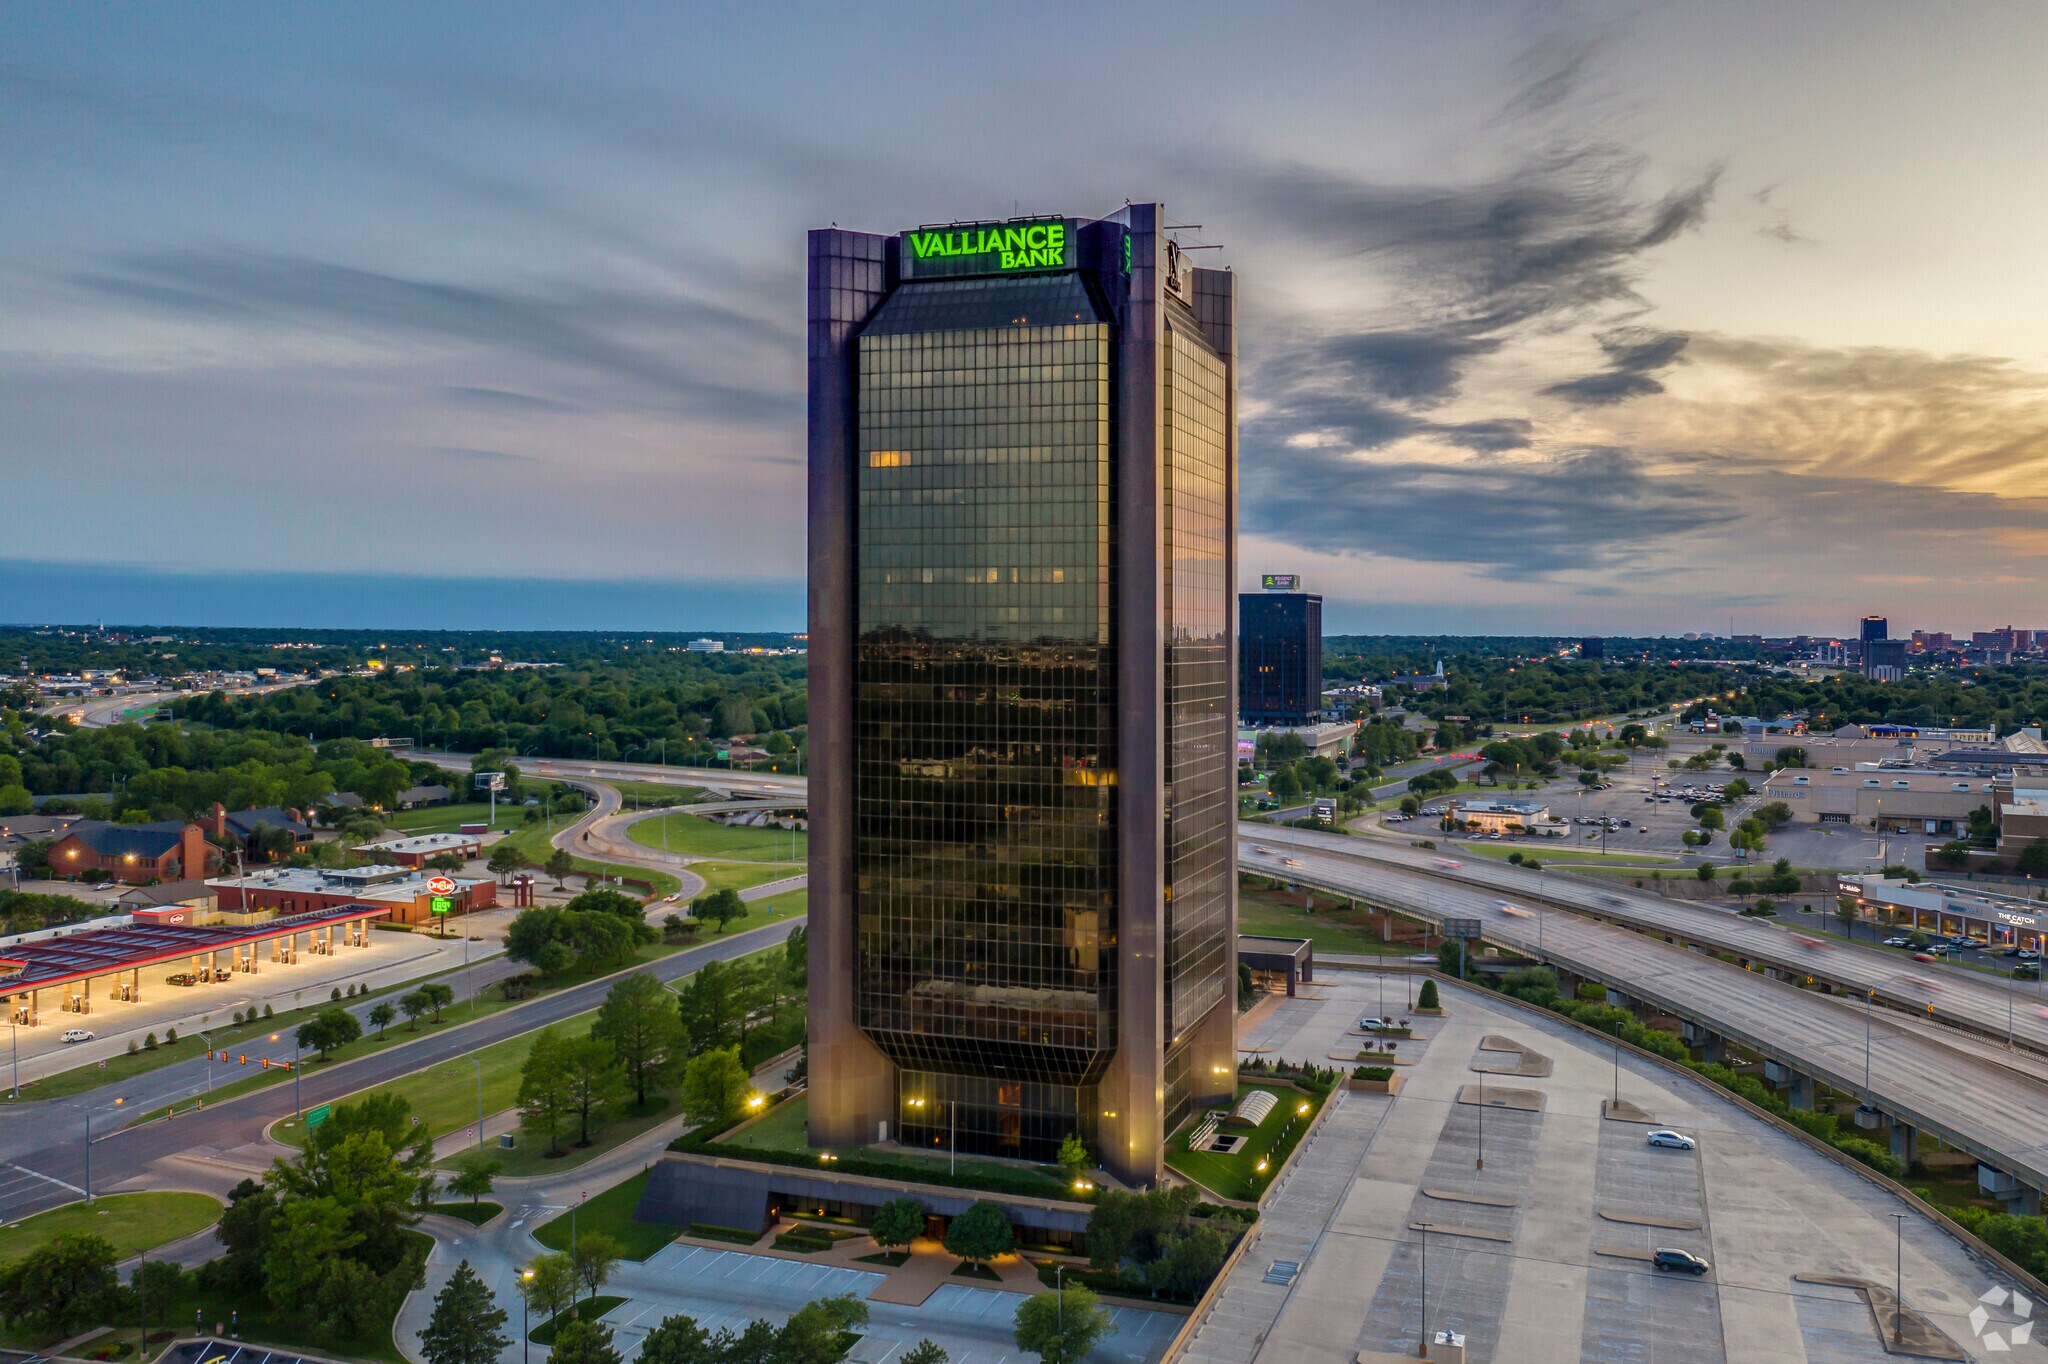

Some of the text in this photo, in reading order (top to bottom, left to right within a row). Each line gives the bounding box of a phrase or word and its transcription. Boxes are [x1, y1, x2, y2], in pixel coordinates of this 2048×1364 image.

[909, 225, 1065, 258] VALLIANCE
[1000, 248, 1064, 269] BANK
[428, 880, 454, 891] OnCue
[1997, 912, 2011, 920] THE
[2011, 915, 2035, 925] CATCH
